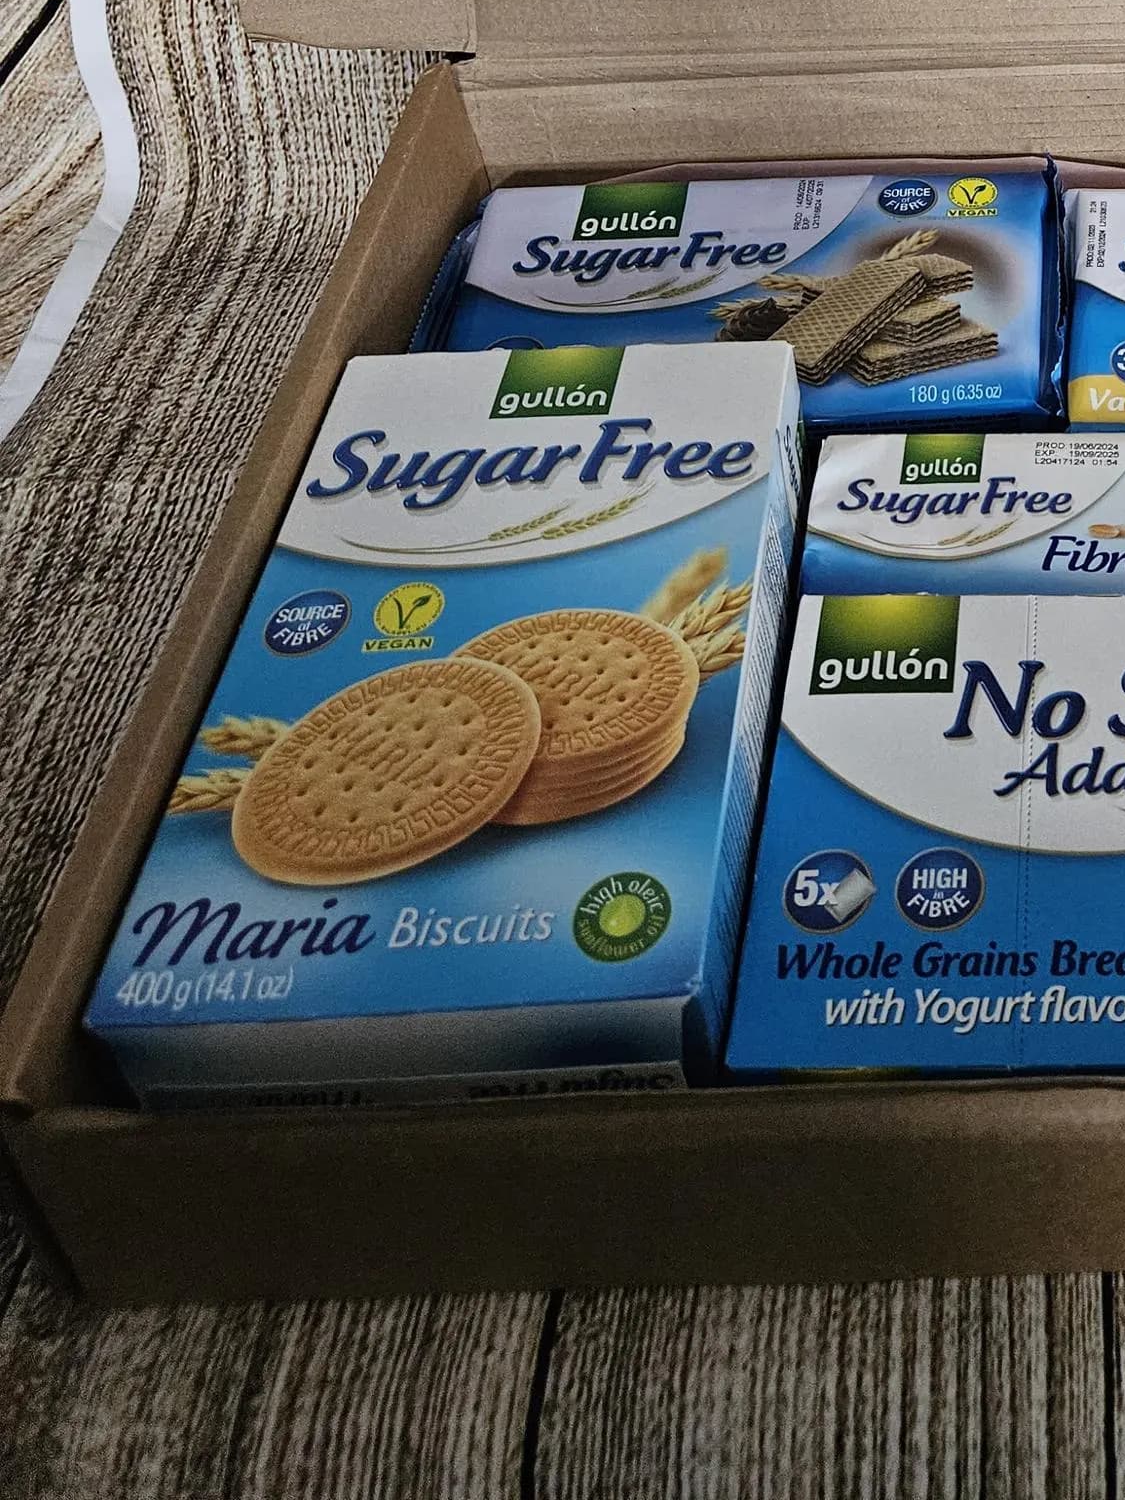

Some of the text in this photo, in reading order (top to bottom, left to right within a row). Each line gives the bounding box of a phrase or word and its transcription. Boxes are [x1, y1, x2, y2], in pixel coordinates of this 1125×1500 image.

[883, 187, 931, 198] SOURCE
[885, 198, 928, 212] FIBRE
[579, 209, 678, 238] gullón
[948, 209, 996, 217] VEGAN
[513, 230, 788, 283] Sugar Free
[499, 382, 607, 414] gullón
[908, 384, 938, 403] 180
[1069, 442, 1119, 451] 19/06/2024
[1069, 450, 1120, 458] 19/09/2025
[305, 429, 584, 510] Sugar
[578, 418, 757, 484] Free
[904, 459, 978, 484] gullón
[837, 475, 1072, 524] Sugar Free
[276, 603, 346, 624] SOURCE
[272, 622, 333, 647] FIBRE
[364, 638, 433, 651] VEGAN
[817, 647, 948, 690] gullón
[942, 659, 1086, 740] No
[793, 870, 839, 908] 5x
[912, 868, 968, 891] HIGH
[580, 876, 664, 915] high oleic
[907, 890, 970, 919] FIBRE
[132, 897, 557, 967] Maria Biscuits
[776, 943, 901, 981] Whole
[912, 940, 1039, 979] Grains
[116, 970, 175, 1007] 400
[824, 988, 906, 1027] with
[913, 988, 1034, 1034] Yogurt
